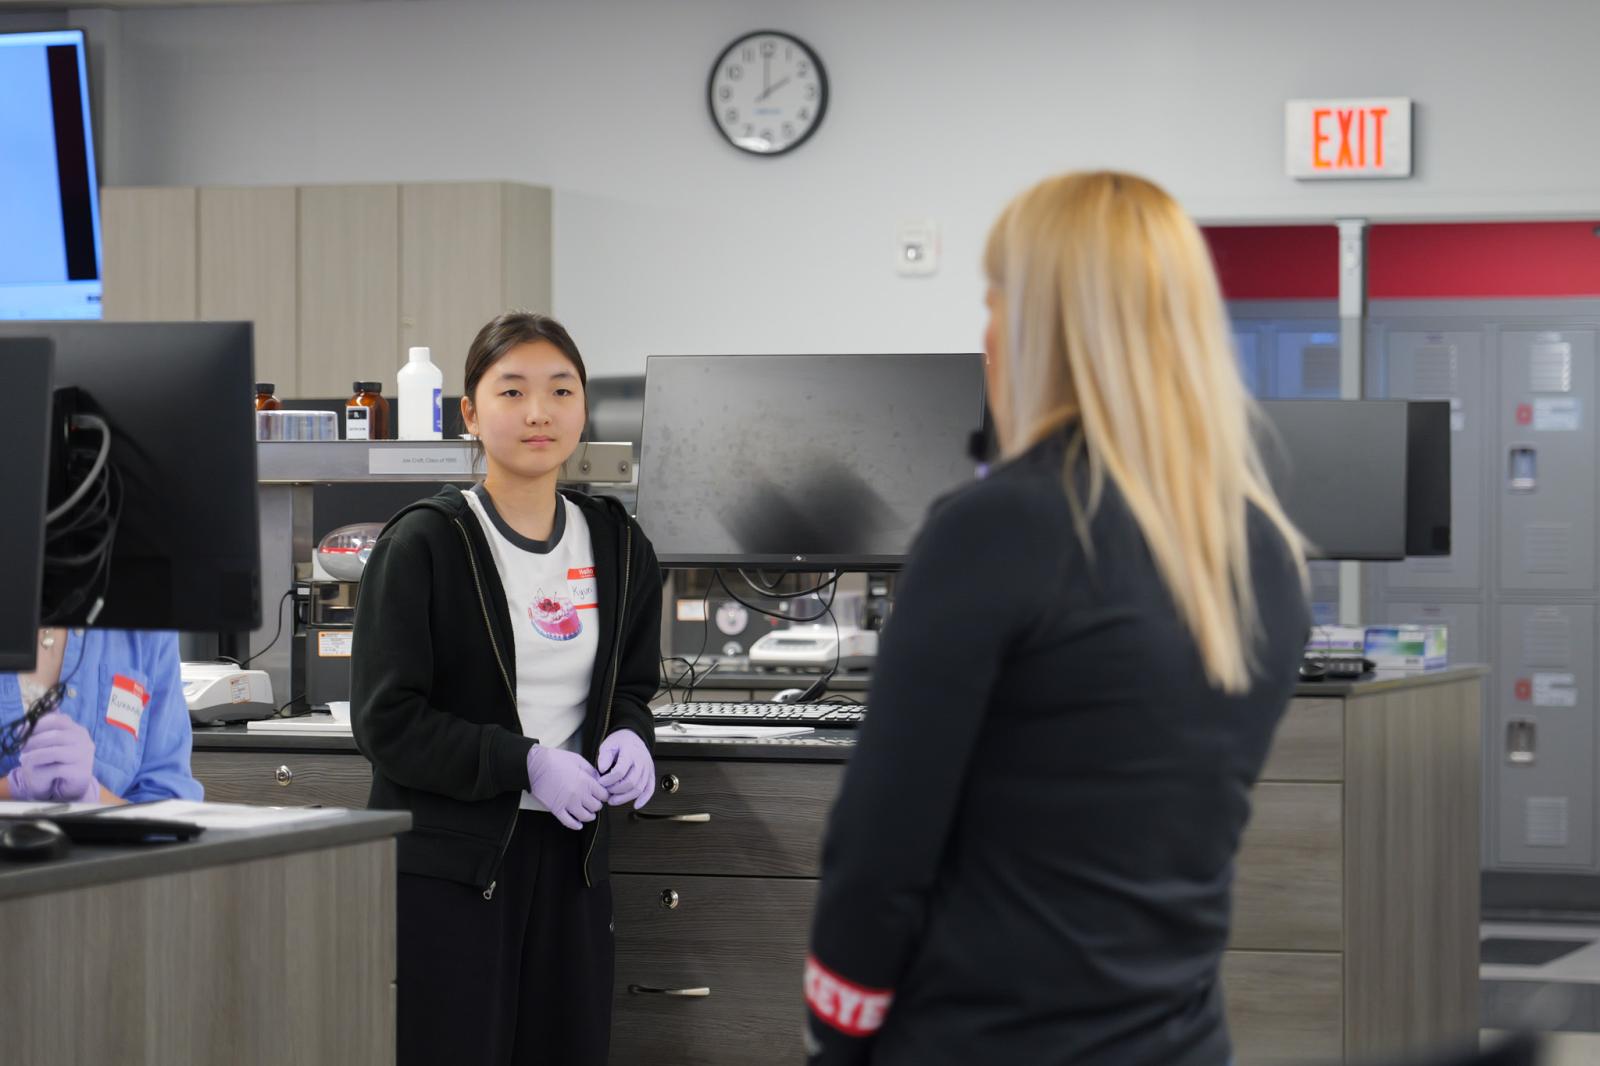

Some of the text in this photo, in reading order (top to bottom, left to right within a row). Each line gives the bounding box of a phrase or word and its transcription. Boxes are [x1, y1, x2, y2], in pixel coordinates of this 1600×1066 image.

[725, 64, 744, 82] 10
[796, 60, 809, 79] 2
[804, 82, 817, 101] 3
[796, 106, 811, 121] 4
[1313, 108, 1388, 168] EXIT
